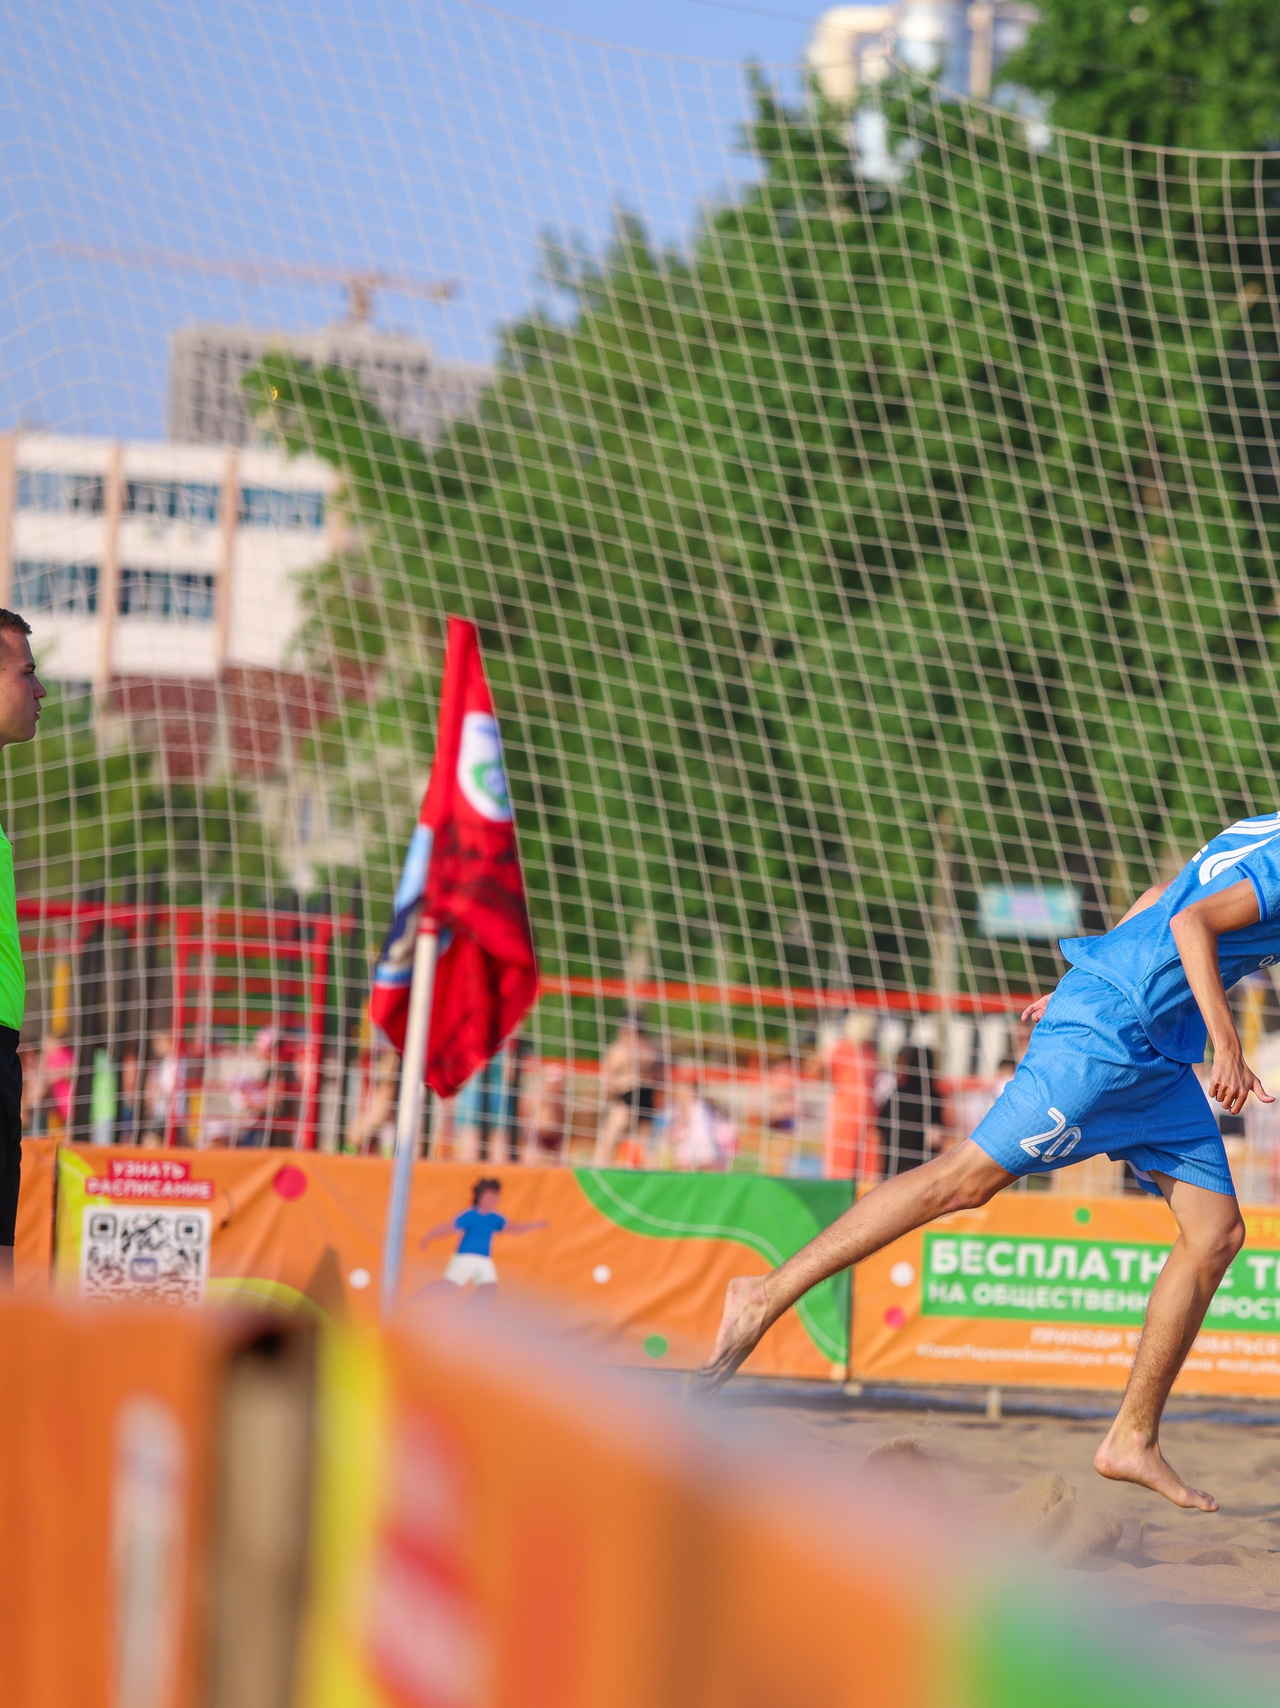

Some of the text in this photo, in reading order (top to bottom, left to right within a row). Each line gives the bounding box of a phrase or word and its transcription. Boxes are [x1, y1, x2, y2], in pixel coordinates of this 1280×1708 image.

[1019, 1107, 1082, 1163] 20
[112, 1159, 186, 1180] УЗНАТЬ
[87, 1178, 212, 1199] РАСПИСАНИЕ
[930, 1238, 1235, 1289] БЕСПЛАТН
[927, 1281, 967, 1305] НА
[971, 1282, 1150, 1313] ОБЩЕСТВЕНН
